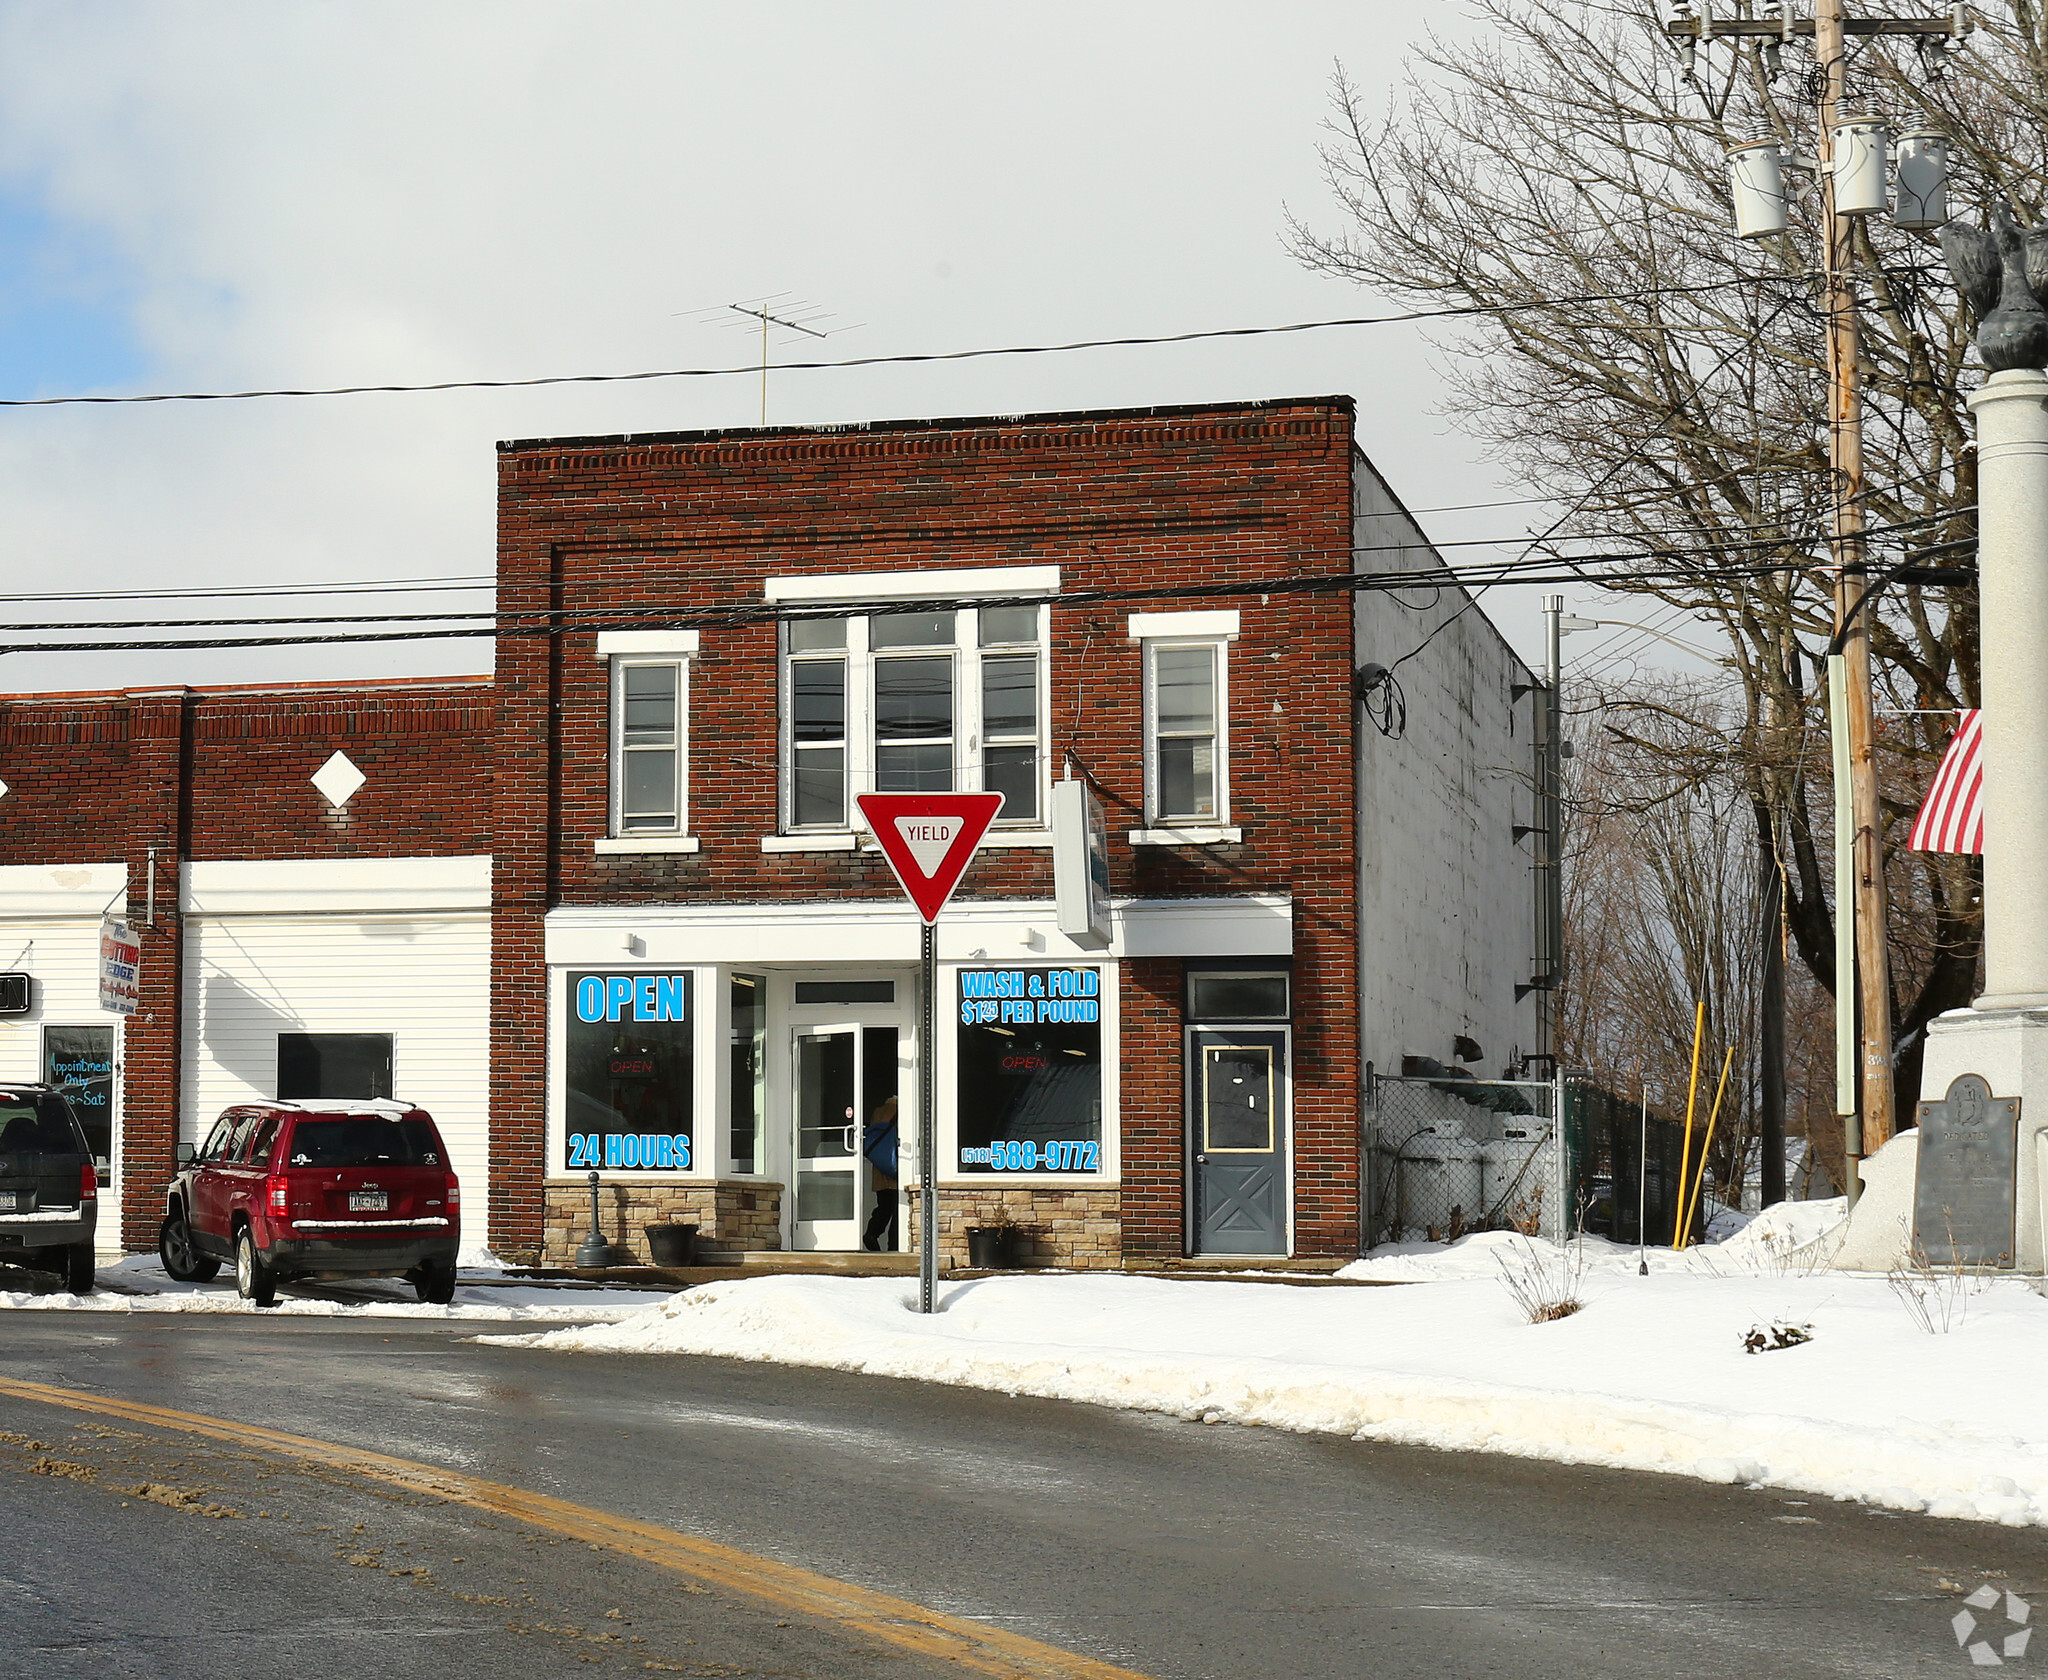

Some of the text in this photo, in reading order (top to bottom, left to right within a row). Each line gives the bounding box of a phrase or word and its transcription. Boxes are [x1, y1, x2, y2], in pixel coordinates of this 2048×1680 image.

[907, 826, 950, 840] YIELD
[106, 962, 134, 982] EDGE
[961, 970, 1098, 998] WASH & FOLD
[576, 975, 685, 1023] OPEN
[1001, 1000, 1034, 1023] PER
[1038, 1000, 1098, 1023] POUND
[611, 1061, 652, 1072] OPEN
[1002, 1056, 1047, 1068] OPEN
[64, 1073, 89, 1090] Only
[569, 1133, 690, 1168] 24 HOURS
